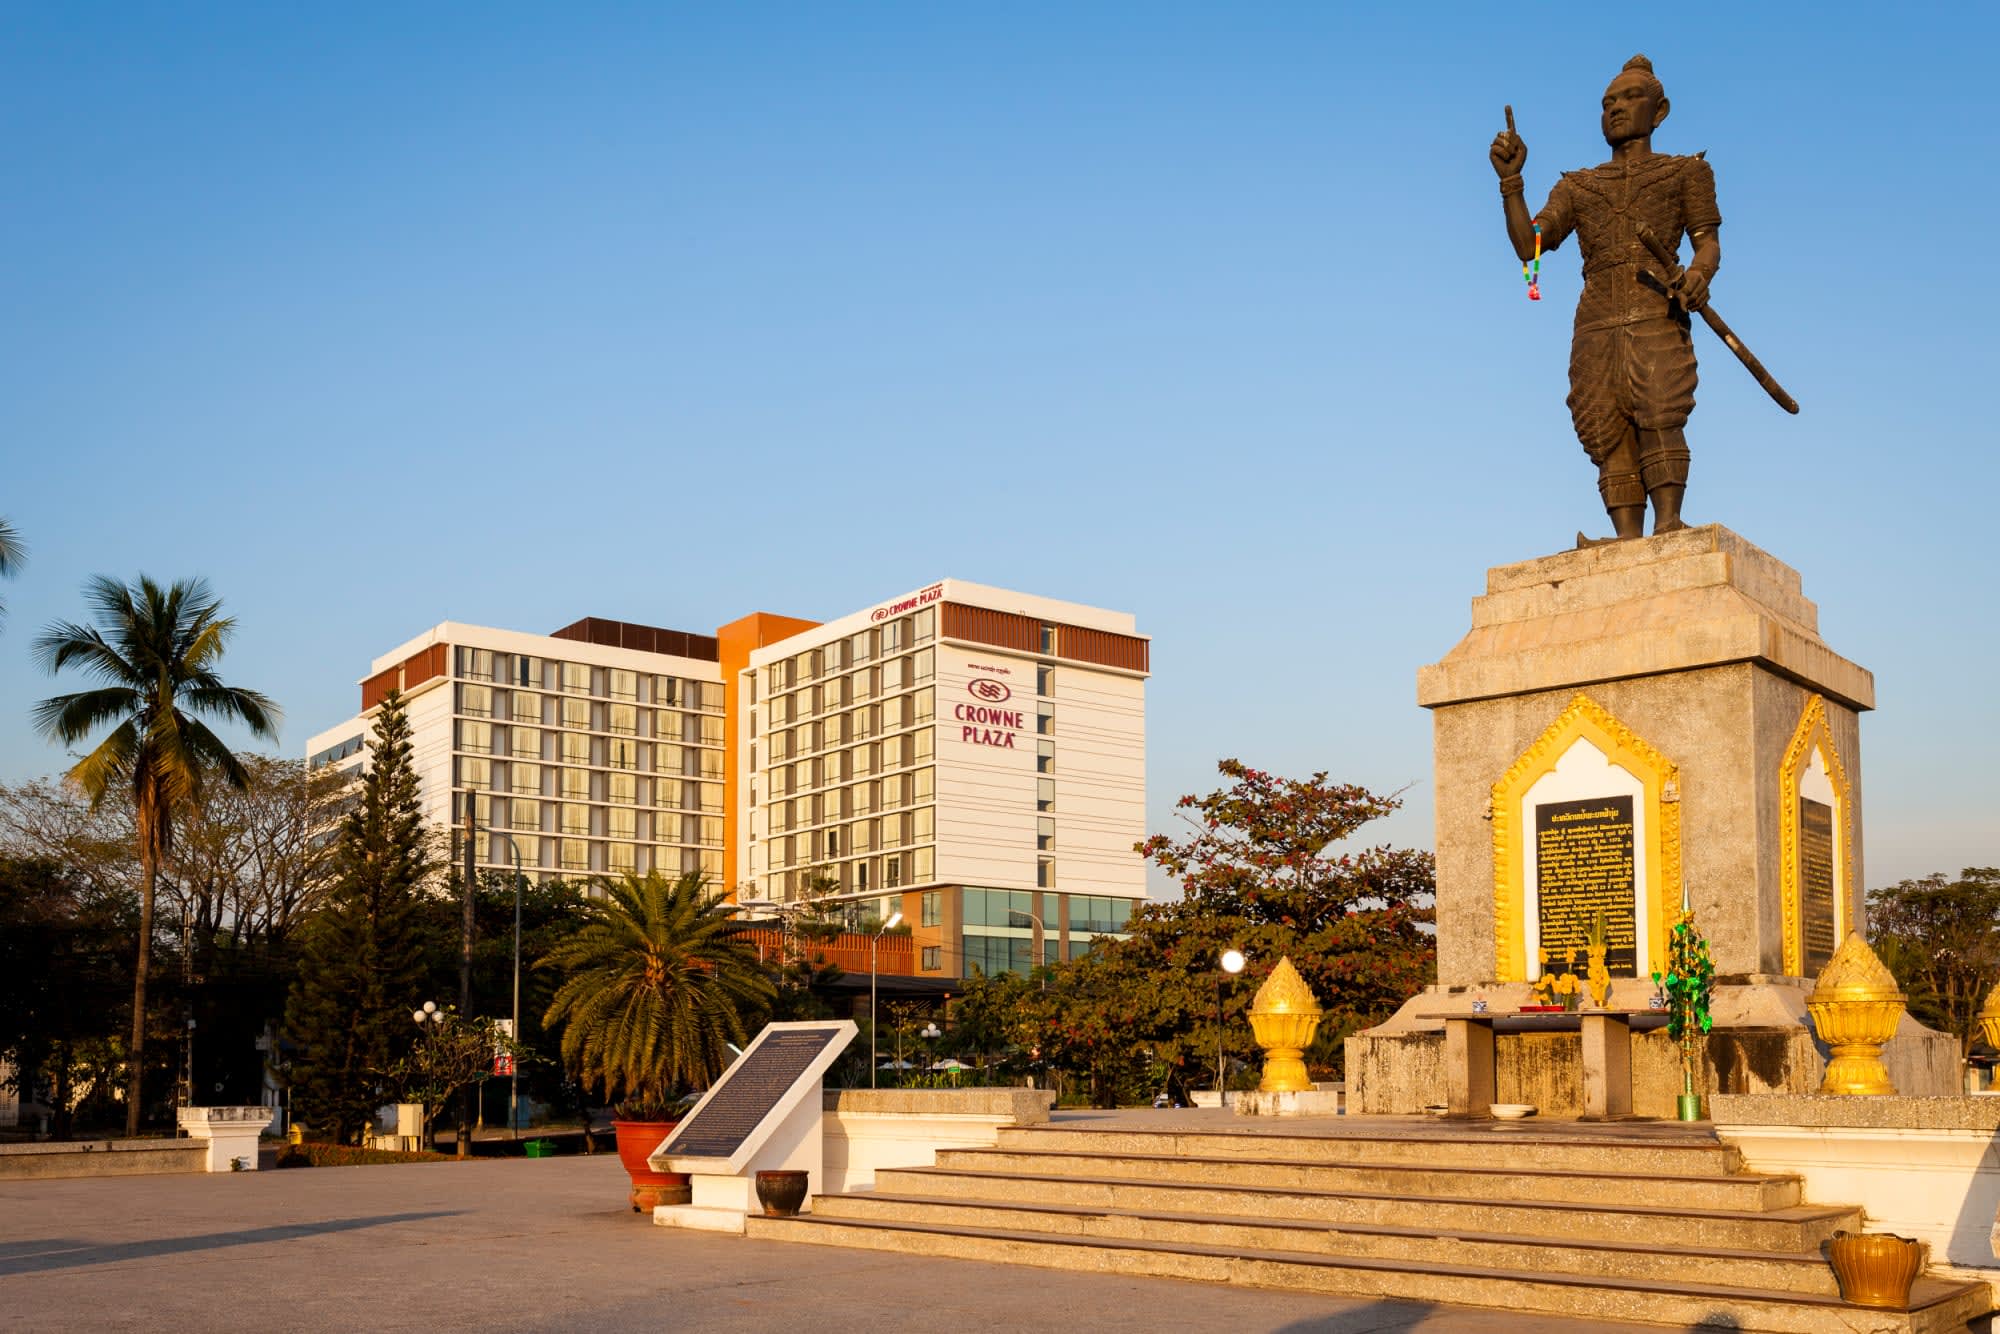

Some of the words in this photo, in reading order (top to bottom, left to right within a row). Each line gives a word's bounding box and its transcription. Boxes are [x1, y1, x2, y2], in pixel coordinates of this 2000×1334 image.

[889, 597, 918, 615] CROWNE
[920, 590, 942, 605] PLAZA
[955, 703, 1024, 729] CROWNE
[962, 726, 1014, 748] PLAZA
